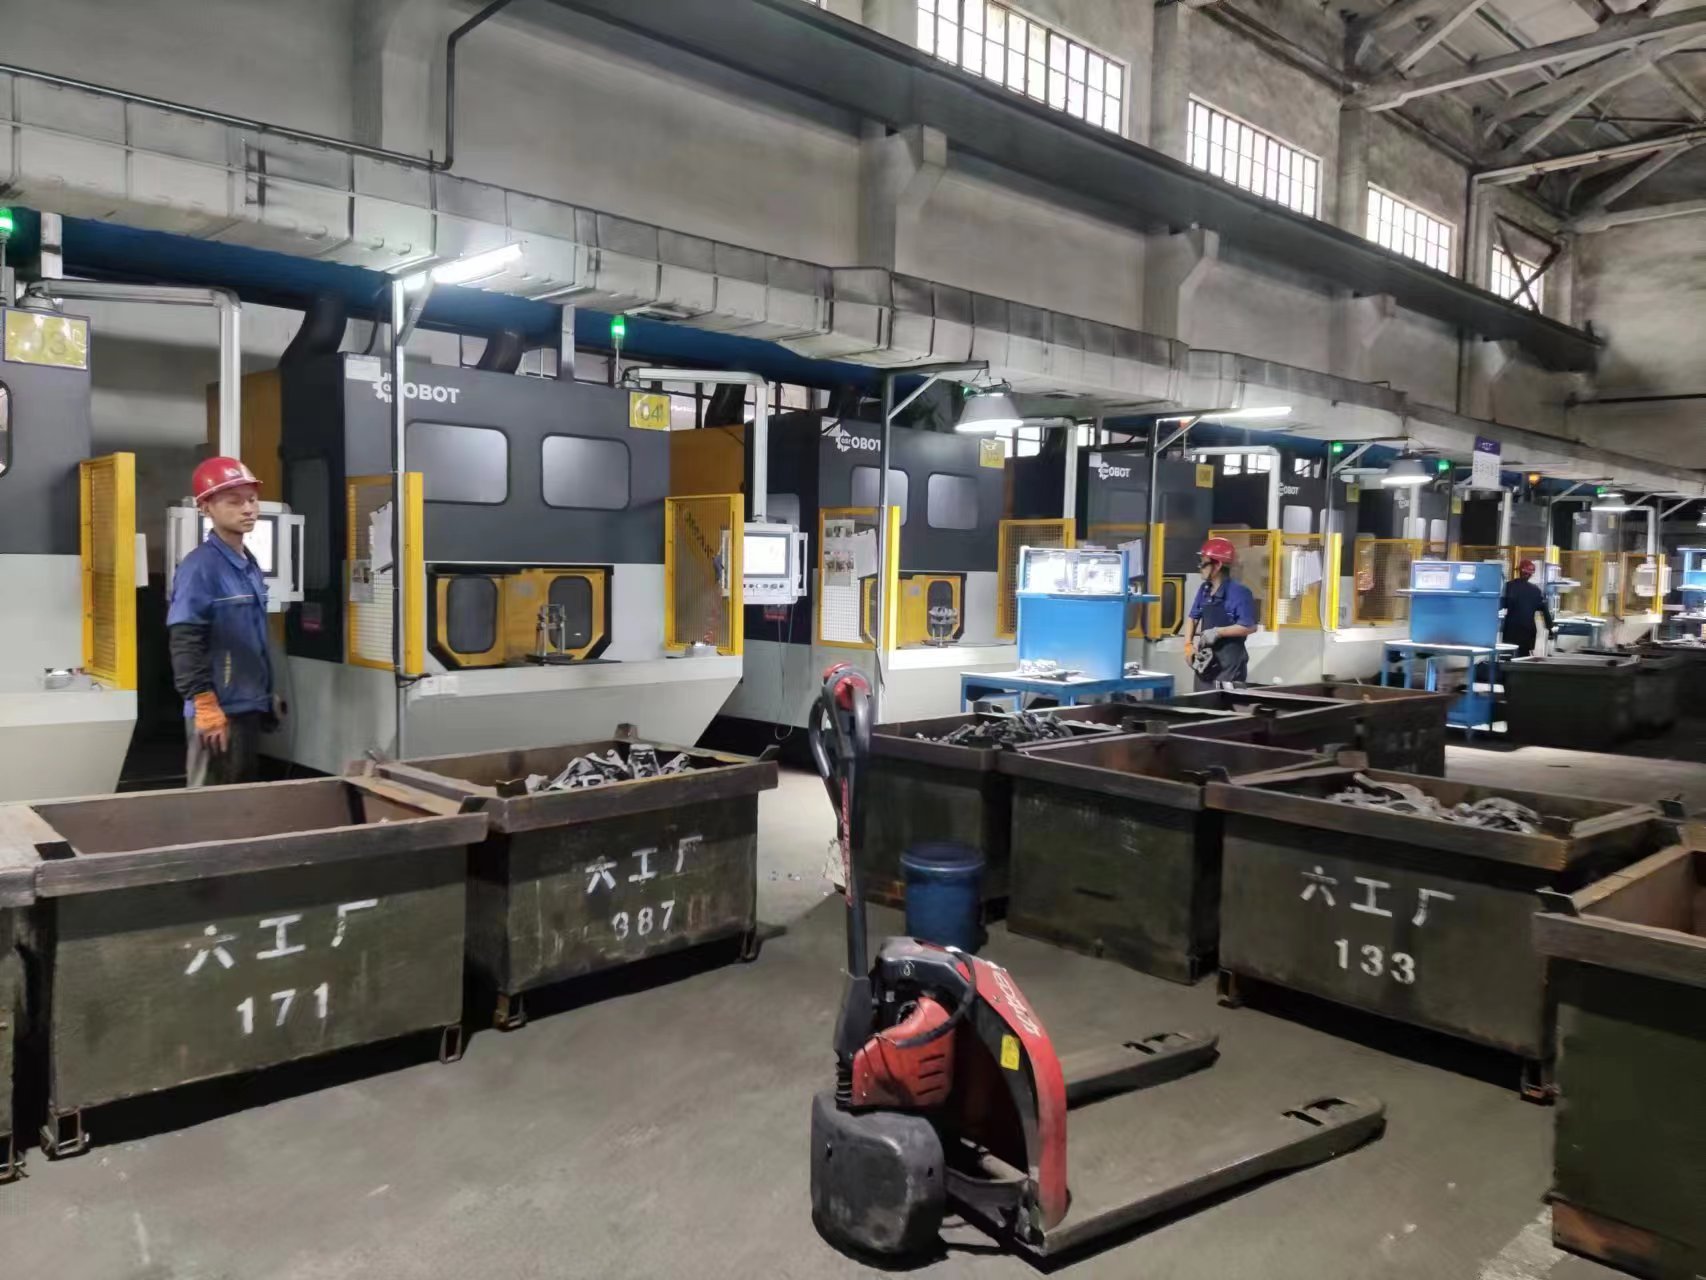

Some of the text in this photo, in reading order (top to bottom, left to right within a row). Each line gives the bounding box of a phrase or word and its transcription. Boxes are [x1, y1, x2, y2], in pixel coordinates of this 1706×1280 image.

[584, 835, 703, 894] 六工厂
[1300, 865, 1456, 926] 六工厂
[1334, 938, 1416, 985] 133
[236, 982, 329, 1034] 171
